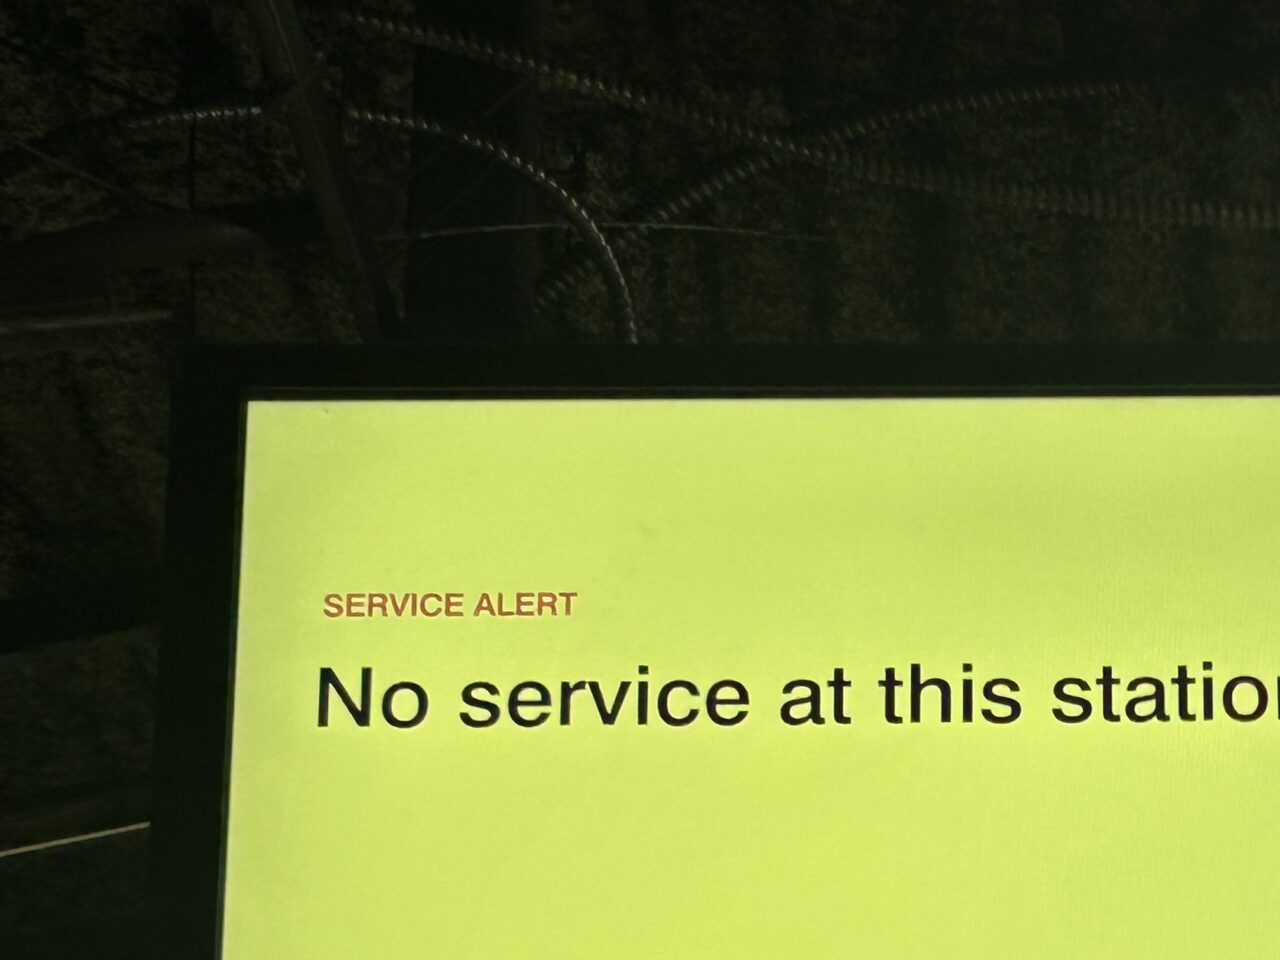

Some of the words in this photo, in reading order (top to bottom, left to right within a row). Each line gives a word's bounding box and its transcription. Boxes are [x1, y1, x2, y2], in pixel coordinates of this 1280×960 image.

[323, 592, 465, 618] SERVICE
[473, 591, 578, 617] ALERT
[317, 666, 429, 729] No
[459, 664, 750, 729] service
[780, 667, 852, 726] at
[877, 662, 1022, 725] this
